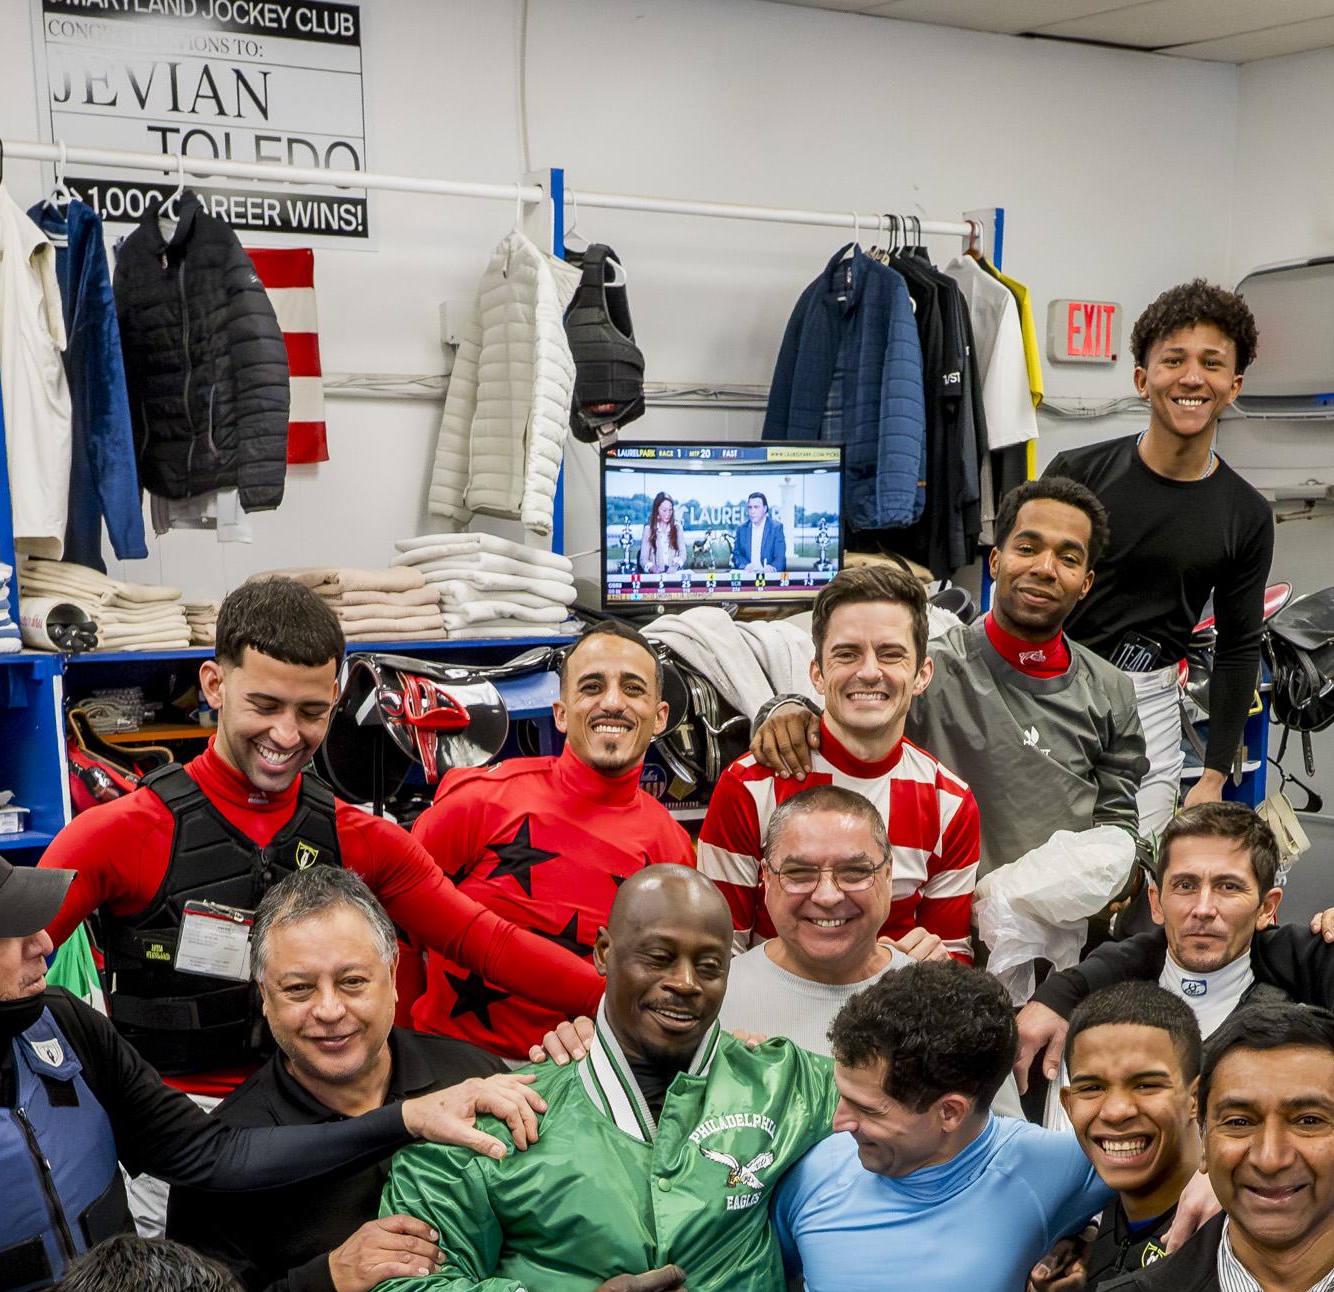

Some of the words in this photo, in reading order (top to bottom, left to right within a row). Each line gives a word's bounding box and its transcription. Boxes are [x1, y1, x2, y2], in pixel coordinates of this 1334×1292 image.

[201, 4, 293, 29] JOCKEY
[295, 8, 355, 36] CLUB
[233, 39, 263, 57] TO:
[53, 56, 272, 120] JEVIAN
[286, 200, 364, 232] WINS!
[1067, 302, 1116, 358] EXIT
[700, 448, 711, 459] 20
[722, 449, 738, 458] FAST
